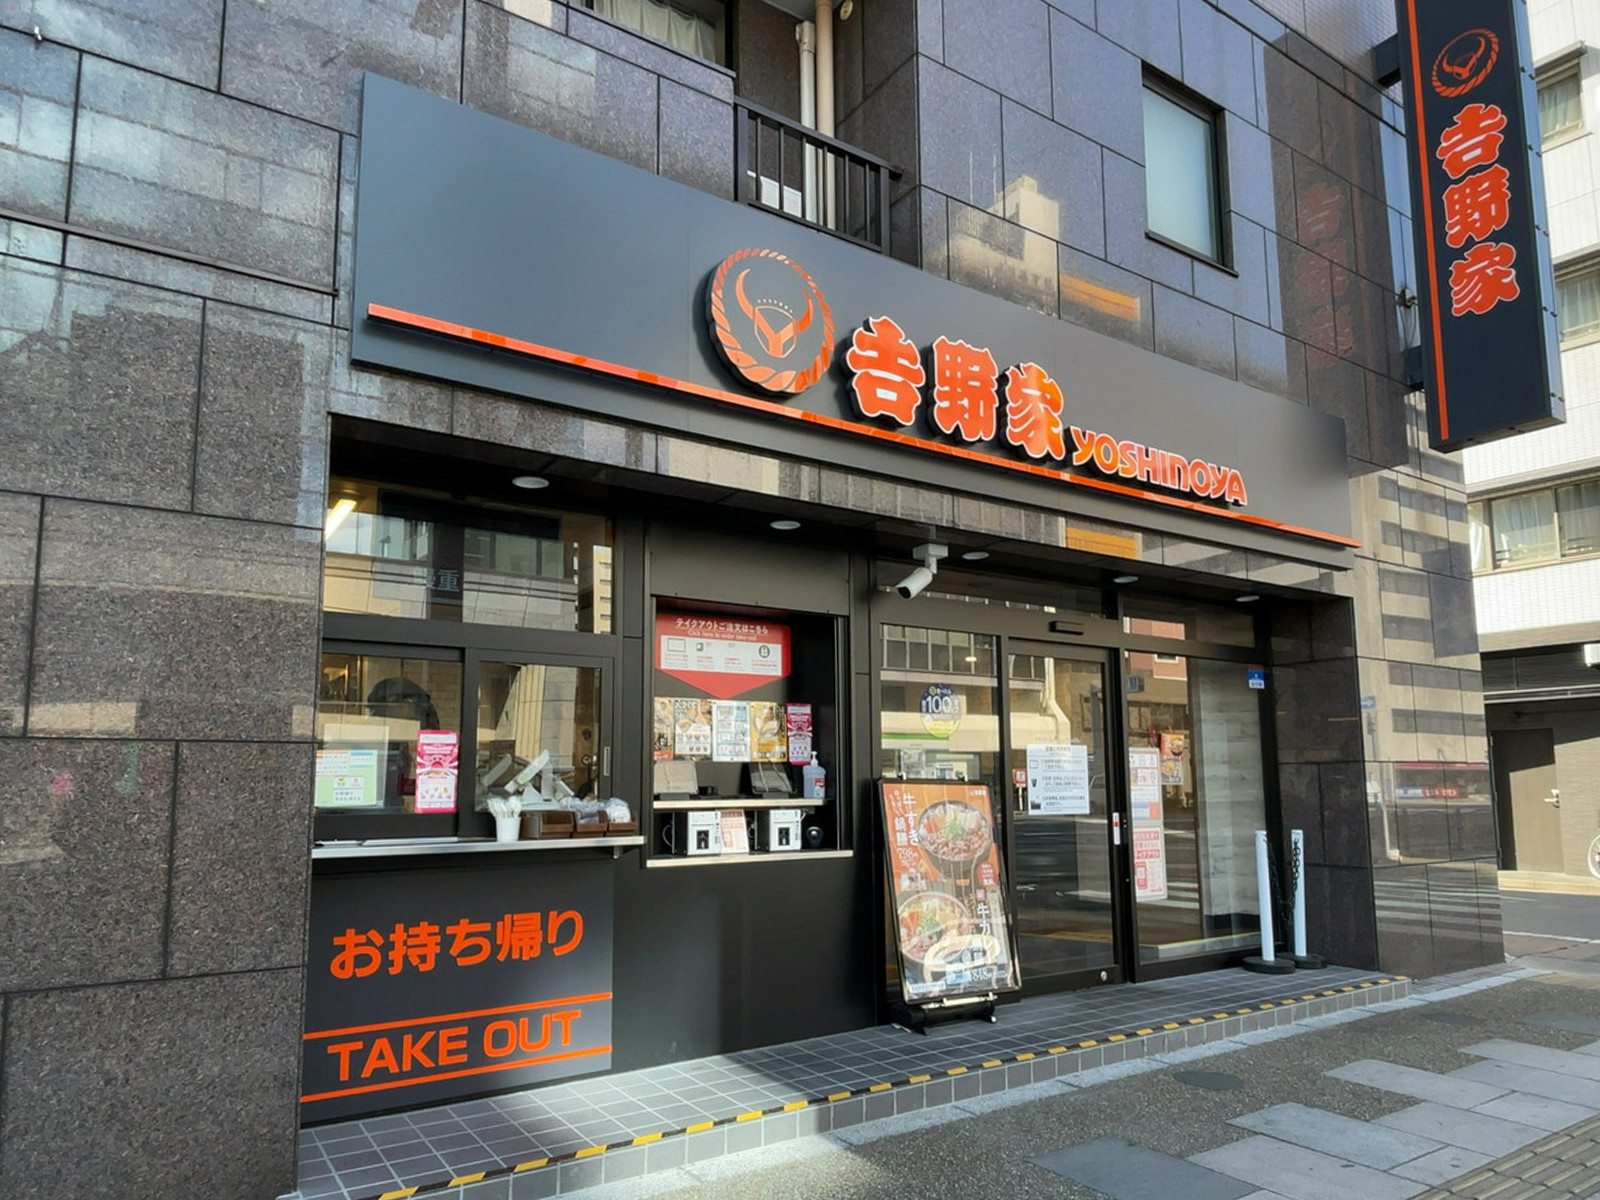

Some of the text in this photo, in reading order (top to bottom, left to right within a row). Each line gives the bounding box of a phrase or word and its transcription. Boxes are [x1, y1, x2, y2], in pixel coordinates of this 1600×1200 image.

[1069, 426, 1248, 506] YOSHINOYA
[330, 909, 584, 979] お持ち帰り
[327, 1009, 581, 1081] TAKE OUT
